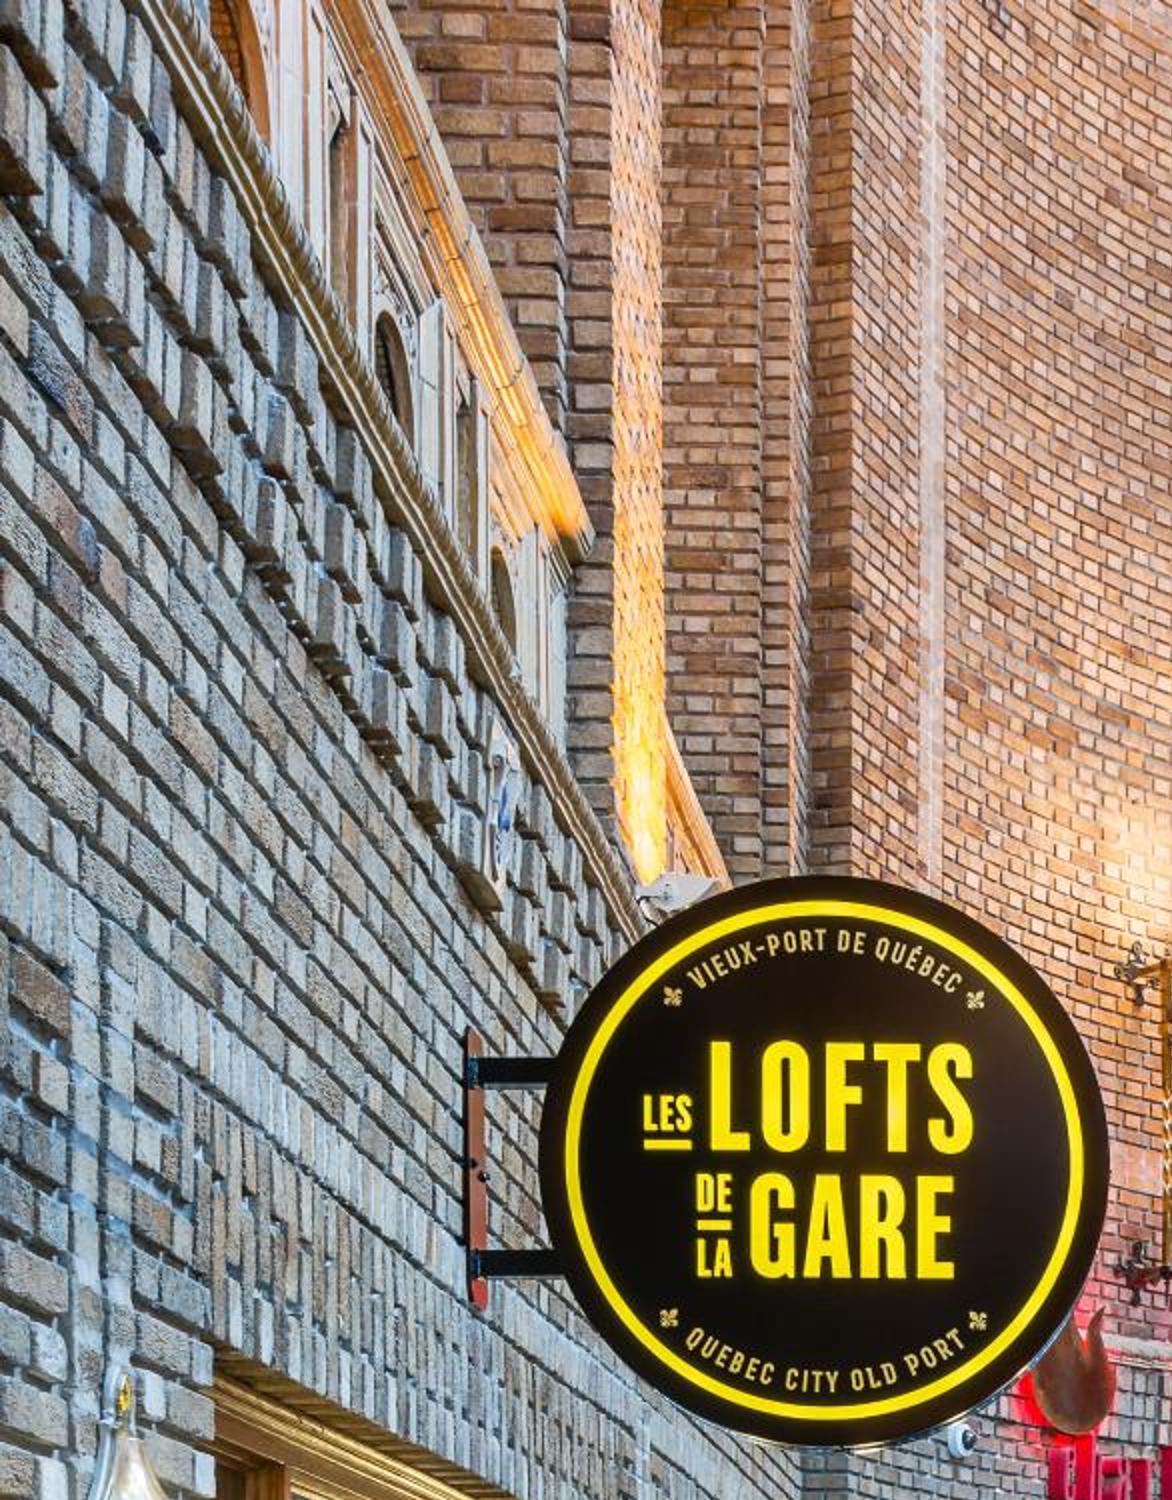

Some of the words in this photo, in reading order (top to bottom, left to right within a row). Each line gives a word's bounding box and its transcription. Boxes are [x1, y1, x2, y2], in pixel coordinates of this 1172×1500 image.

[687, 928, 827, 990] VIEUX-PORT
[837, 929, 867, 955] DE
[874, 936, 963, 993] QUÉBEC
[643, 1094, 693, 1132] LES
[709, 1039, 974, 1155] LOFTS
[697, 1173, 732, 1213] DE
[697, 1239, 733, 1278] LA
[749, 1171, 955, 1281] GARE
[685, 1327, 775, 1386] QUEBEC
[785, 1368, 839, 1393] CITY
[850, 1362, 897, 1392] OLD
[903, 1327, 966, 1377] PORT
